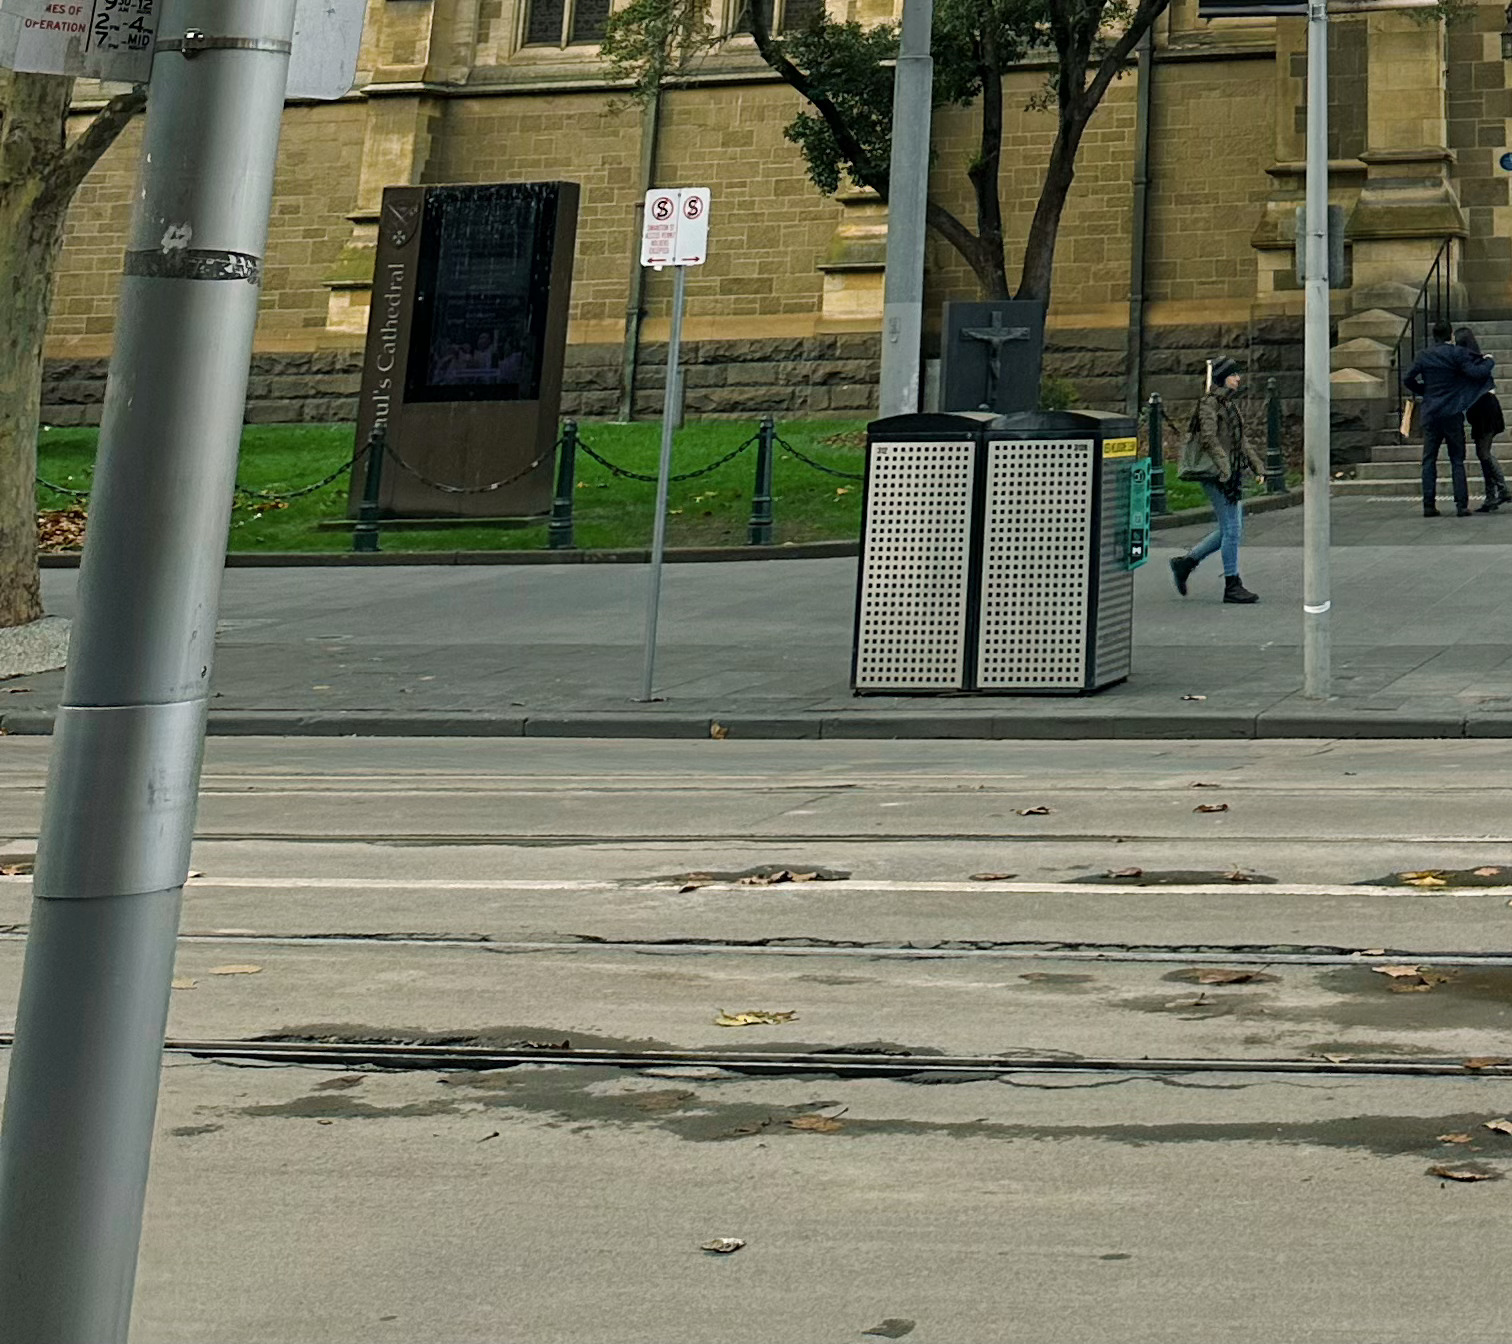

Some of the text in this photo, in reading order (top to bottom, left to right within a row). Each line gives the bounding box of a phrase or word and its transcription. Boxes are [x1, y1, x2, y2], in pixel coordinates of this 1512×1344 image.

[68, 5, 84, 16] OF
[95, 13, 110, 29] 2
[128, 16, 144, 32] 4
[95, 31, 109, 47] 7
[127, 33, 150, 46] MID
[372, 263, 405, 429] aul's Cathedral
